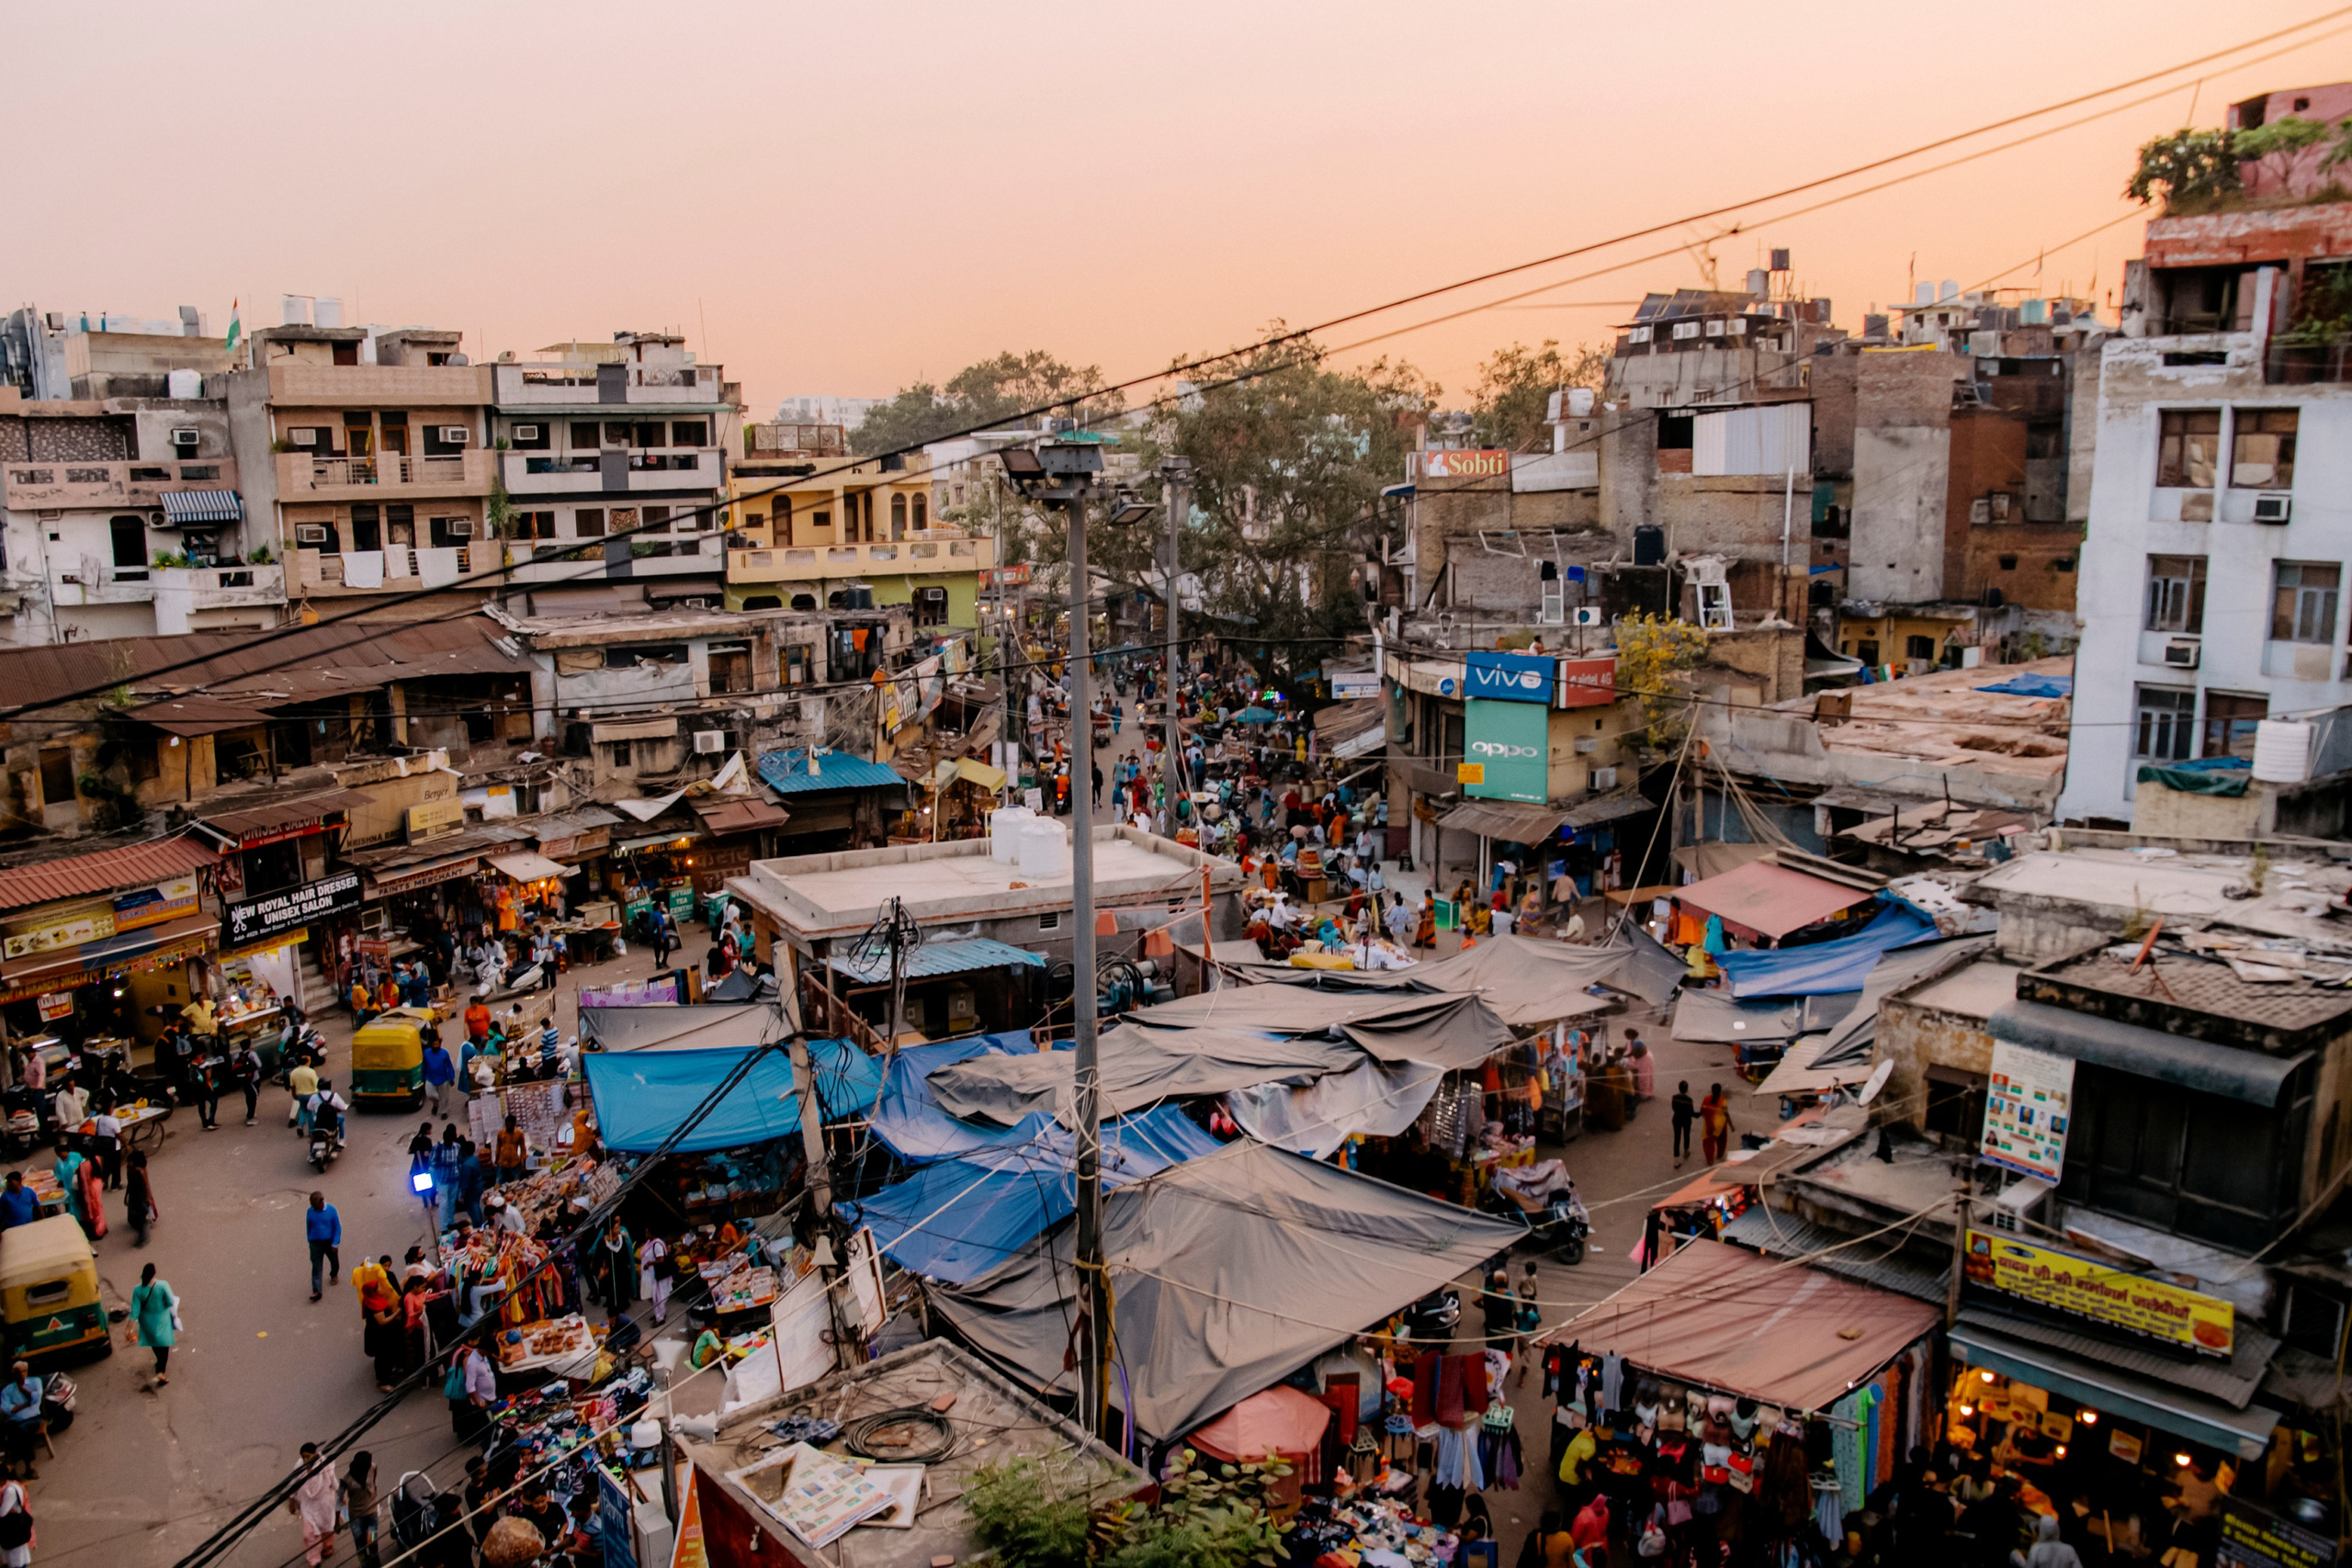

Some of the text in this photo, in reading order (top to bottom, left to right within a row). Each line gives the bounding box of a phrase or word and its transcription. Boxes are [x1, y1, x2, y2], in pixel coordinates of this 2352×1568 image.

[1448, 452, 1503, 475] Sobti
[1476, 663, 1542, 689] vivo
[1600, 672, 1611, 685] 4G
[424, 787, 449, 800] Berger
[346, 833, 384, 848] KRISHNA
[379, 868, 463, 896] PAINTS MERCHANT
[153, 897, 196, 913] CATERERS
[232, 905, 256, 923] NEW
[257, 896, 290, 915] ROYAL
[291, 887, 316, 905] HAIR
[317, 875, 359, 897] DRESSER
[265, 895, 334, 925] UNISEX SALON
